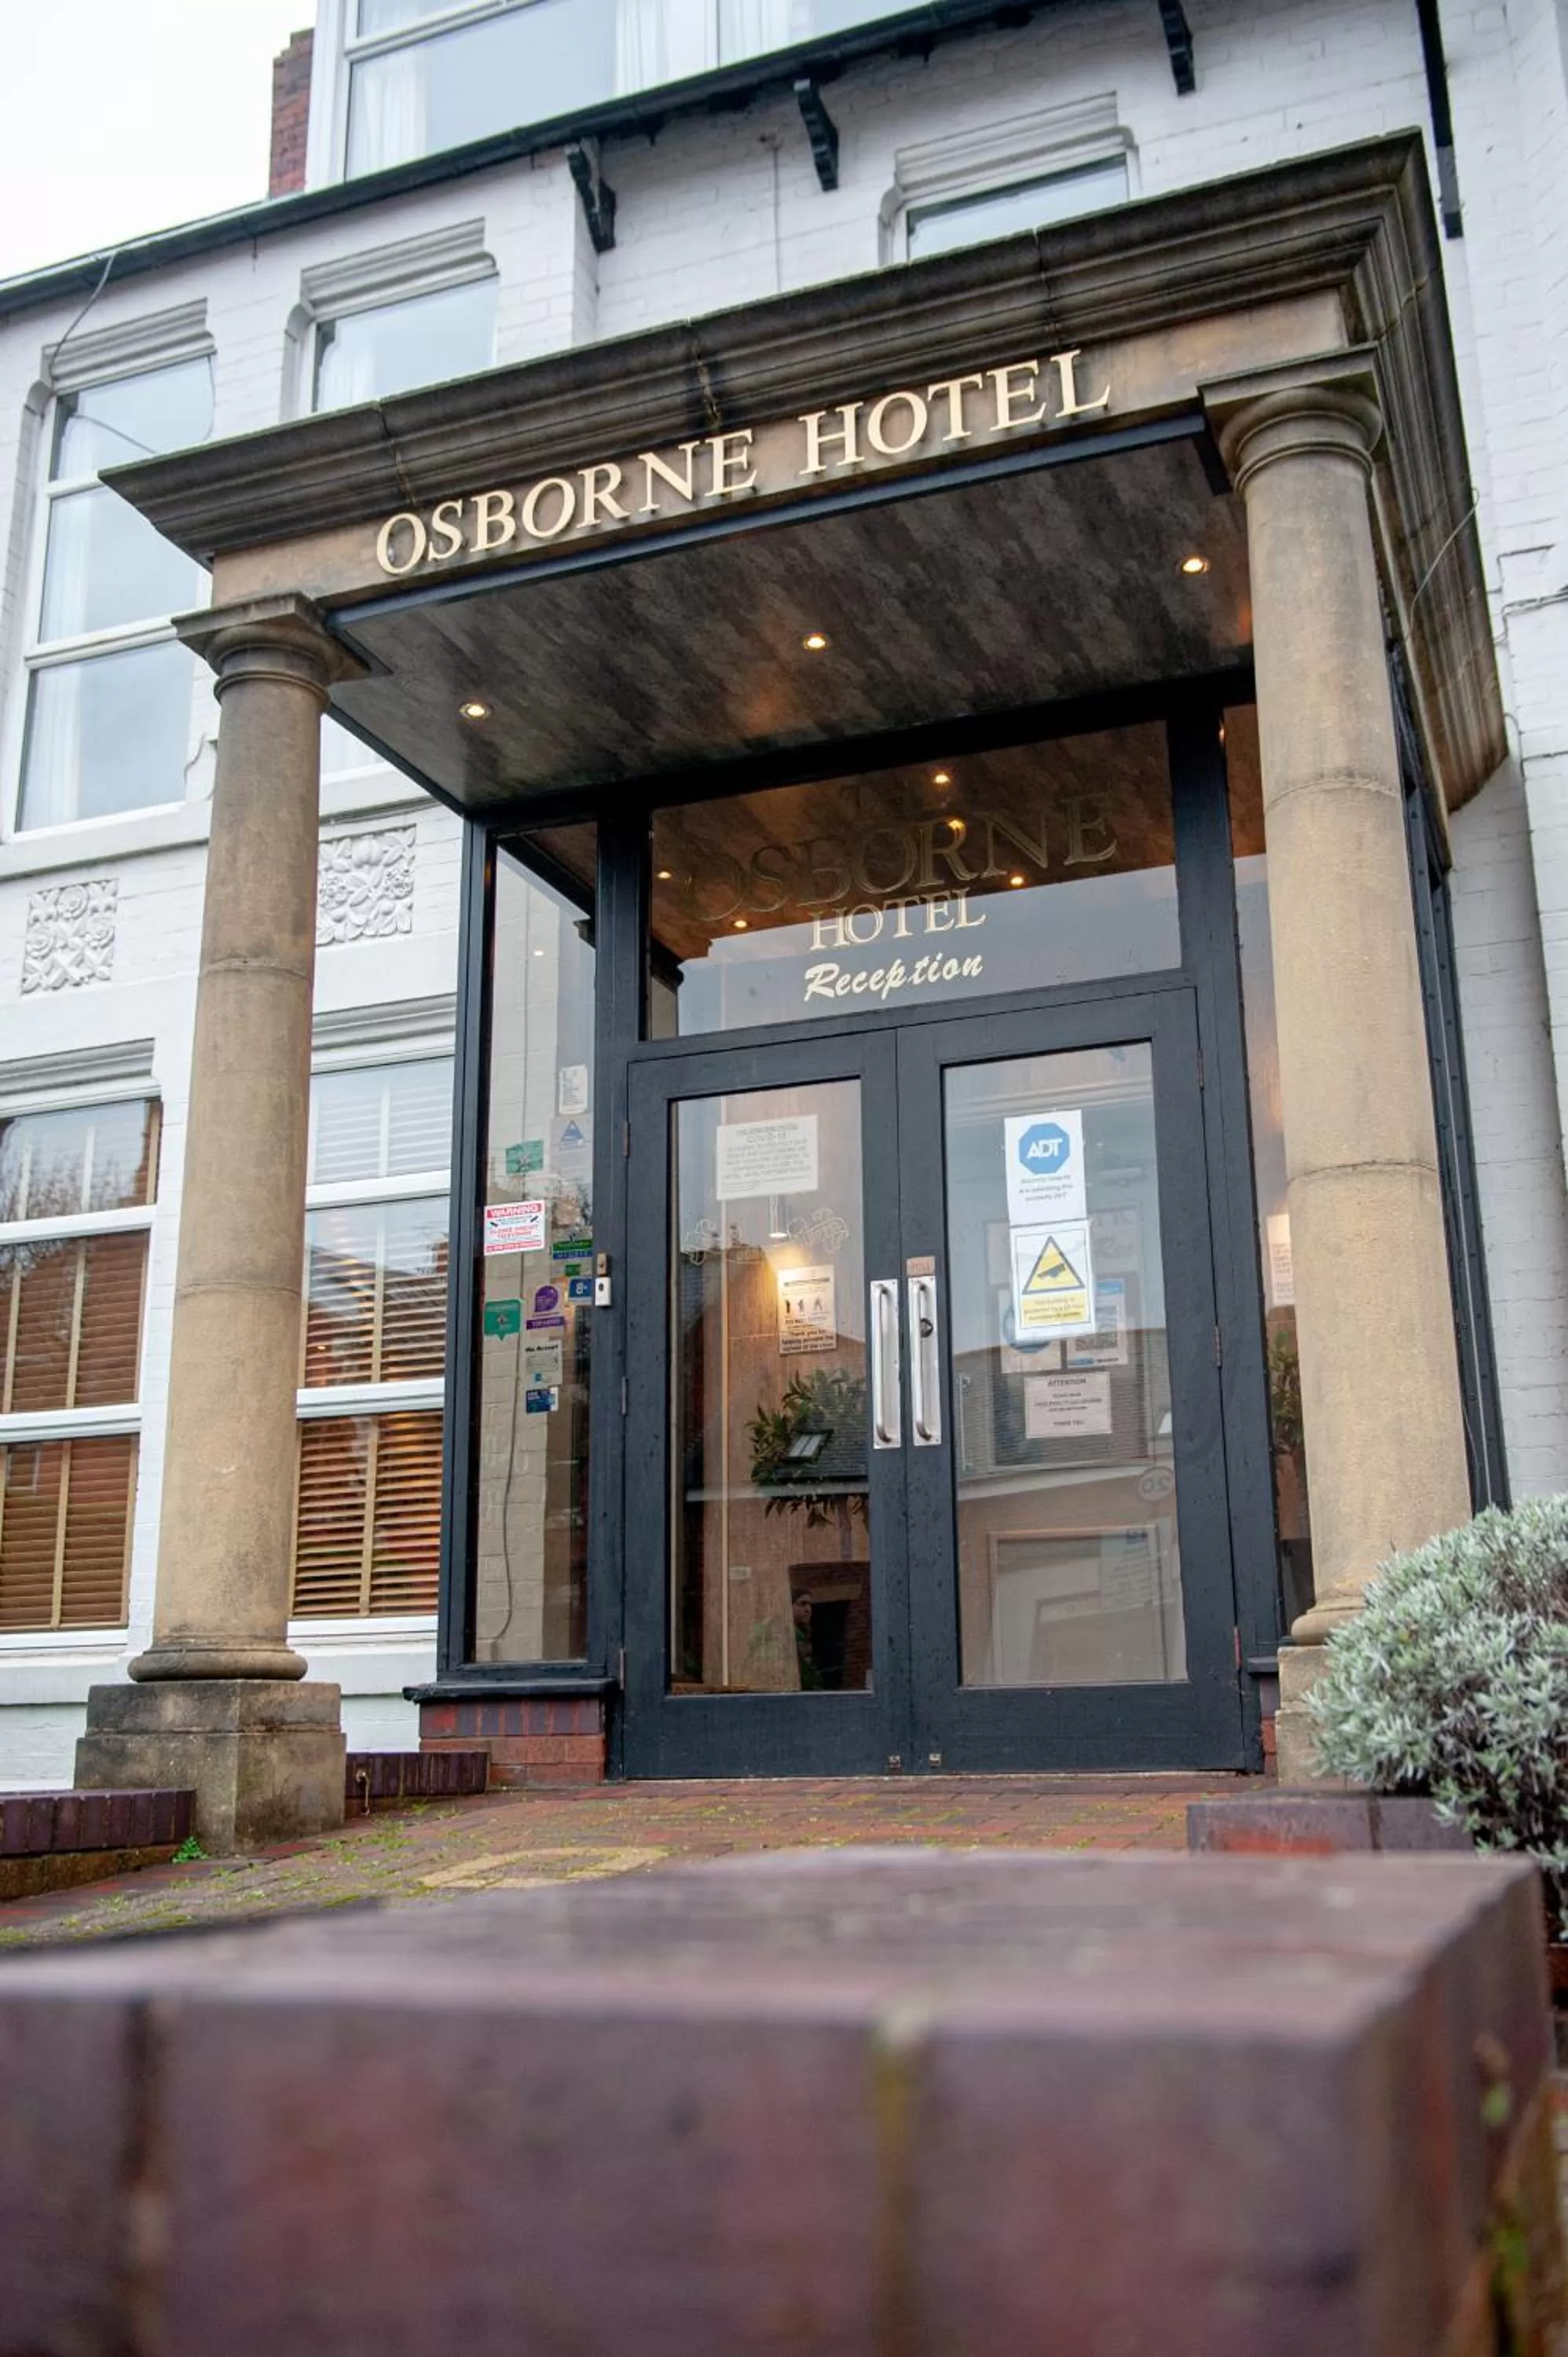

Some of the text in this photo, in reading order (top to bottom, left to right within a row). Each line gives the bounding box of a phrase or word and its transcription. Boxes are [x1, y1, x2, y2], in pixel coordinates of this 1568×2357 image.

[376, 348, 1111, 576] OSBORNE HOTEL
[683, 792, 1117, 922] OSBORNE
[810, 888, 986, 951] HOTEL
[804, 951, 984, 1002] Reception
[1027, 1138, 1064, 1160] ADT
[491, 1204, 539, 1218] WARNING
[1047, 1377, 1086, 1387] ATTENTION
